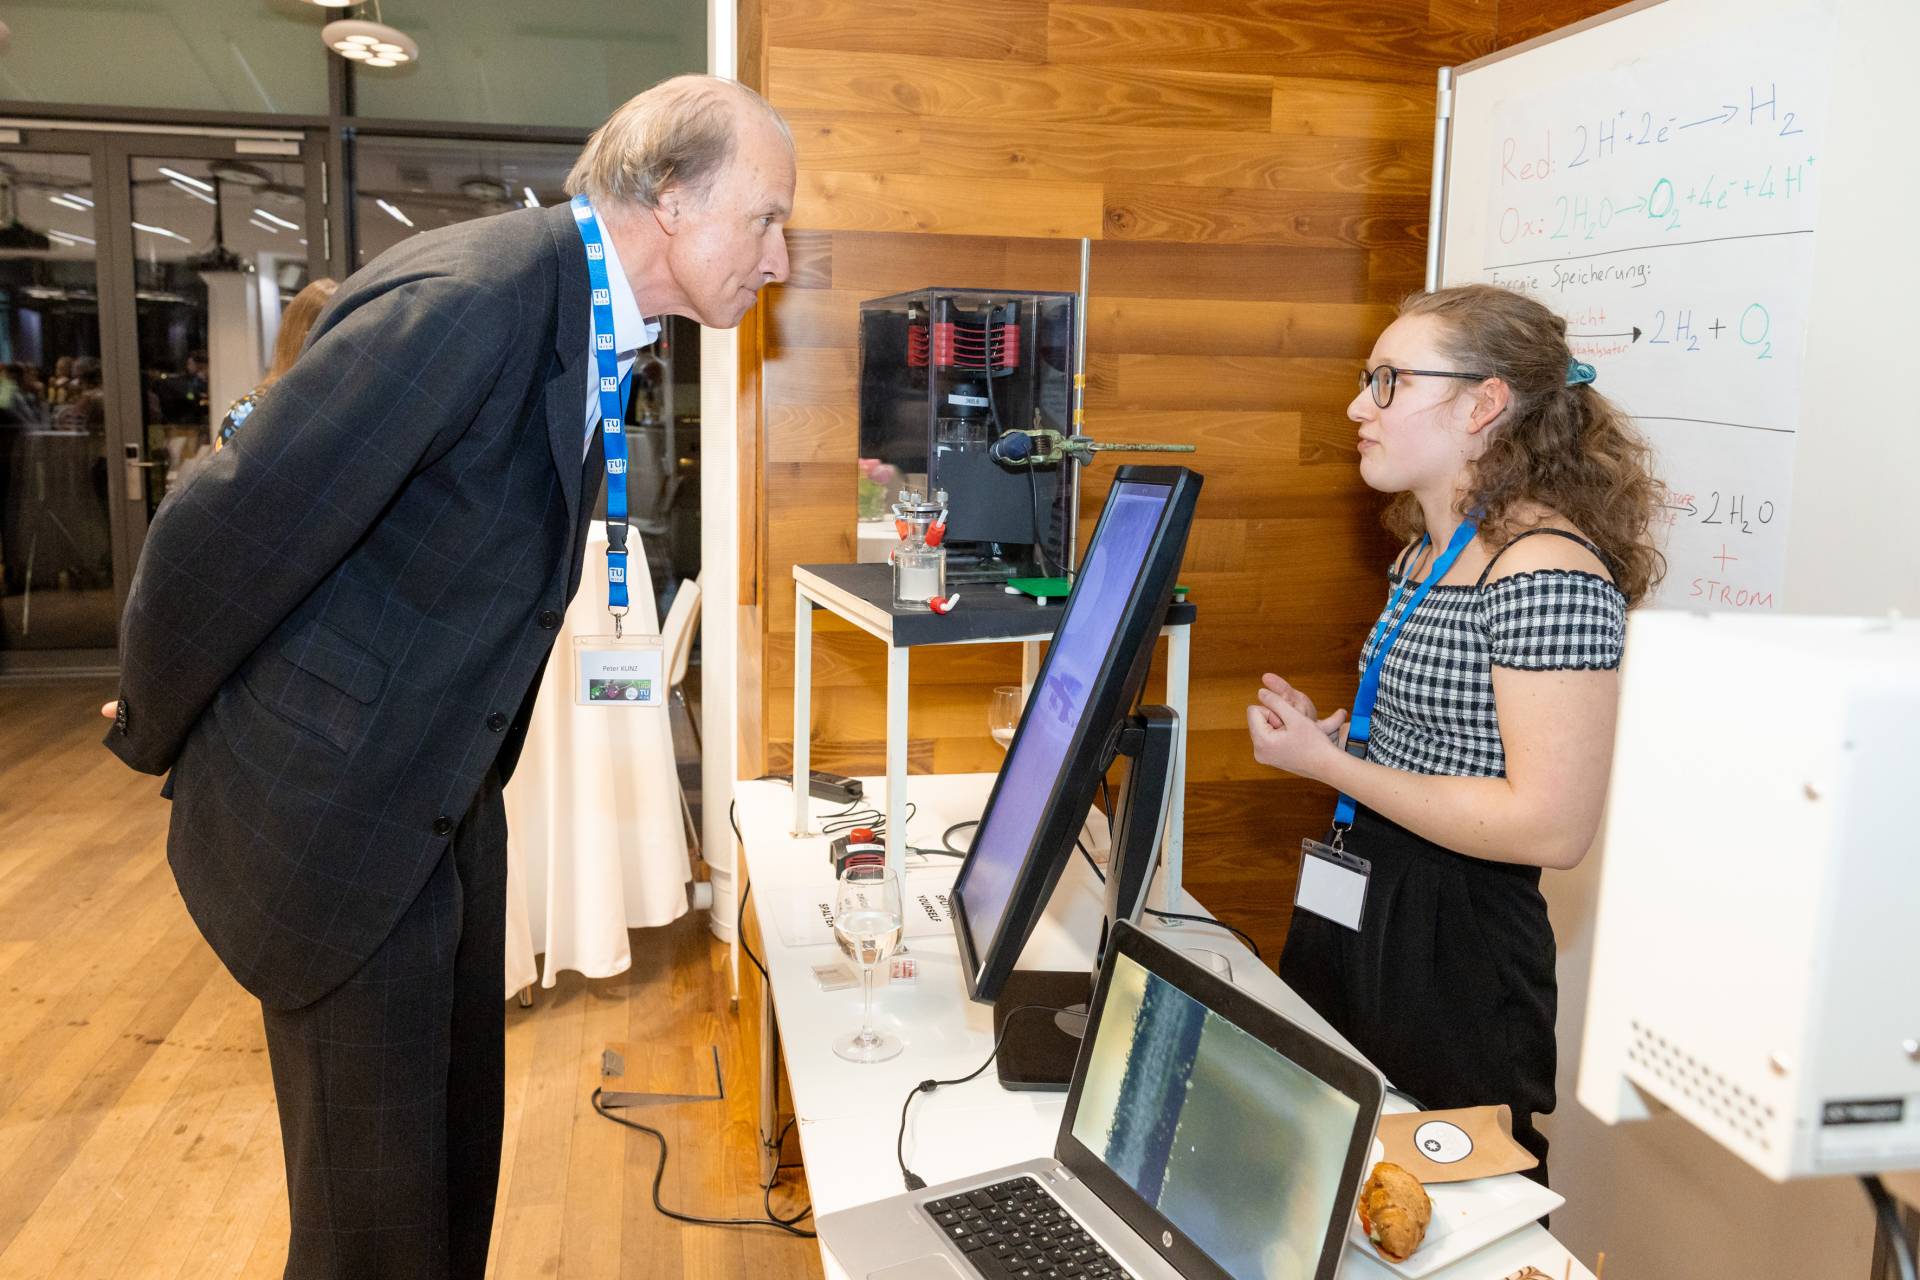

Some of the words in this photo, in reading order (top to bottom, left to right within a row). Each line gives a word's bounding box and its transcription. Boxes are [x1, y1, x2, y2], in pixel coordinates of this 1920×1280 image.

[588, 245, 601, 254] TU
[1551, 264, 1651, 293] Speicherung:
[593, 290, 607, 299] TU
[598, 335, 612, 344] TU
[602, 378, 616, 386] TU
[604, 419, 619, 428] TU
[608, 459, 621, 468] TU
[609, 568, 623, 577] TU
[1689, 578, 1774, 608] STROM
[917, 895, 942, 922] YOURSELF
